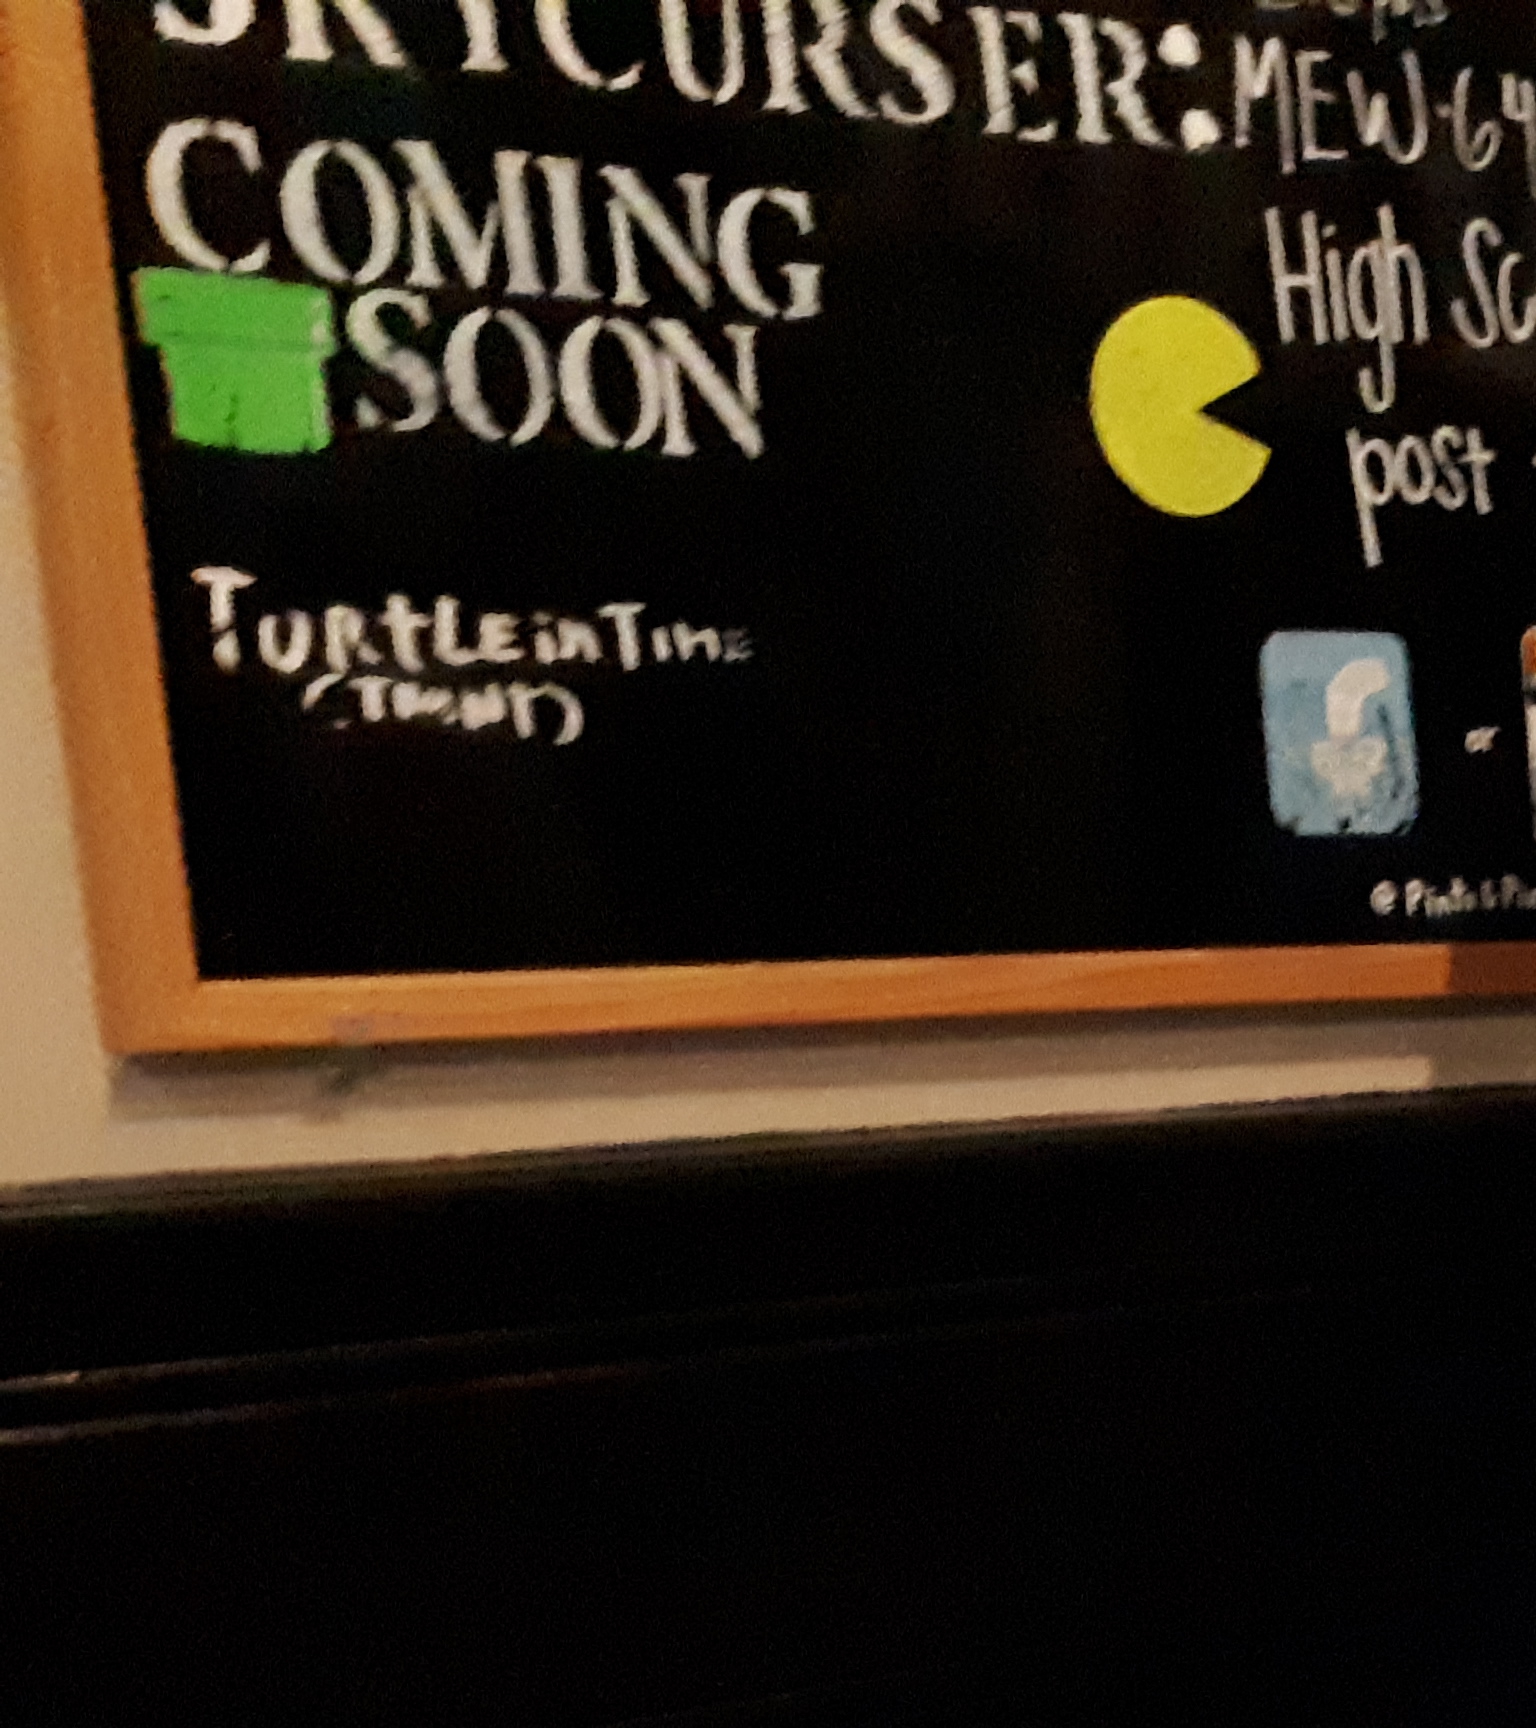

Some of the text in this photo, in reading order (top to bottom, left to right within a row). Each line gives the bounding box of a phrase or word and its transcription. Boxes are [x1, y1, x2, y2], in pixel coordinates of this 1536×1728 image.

[152, 0, 1222, 150] CURSER:
[146, 118, 823, 320] COMING
[345, 288, 764, 459] SOON
[1264, 204, 1429, 413] High
[1346, 426, 1495, 567] post
